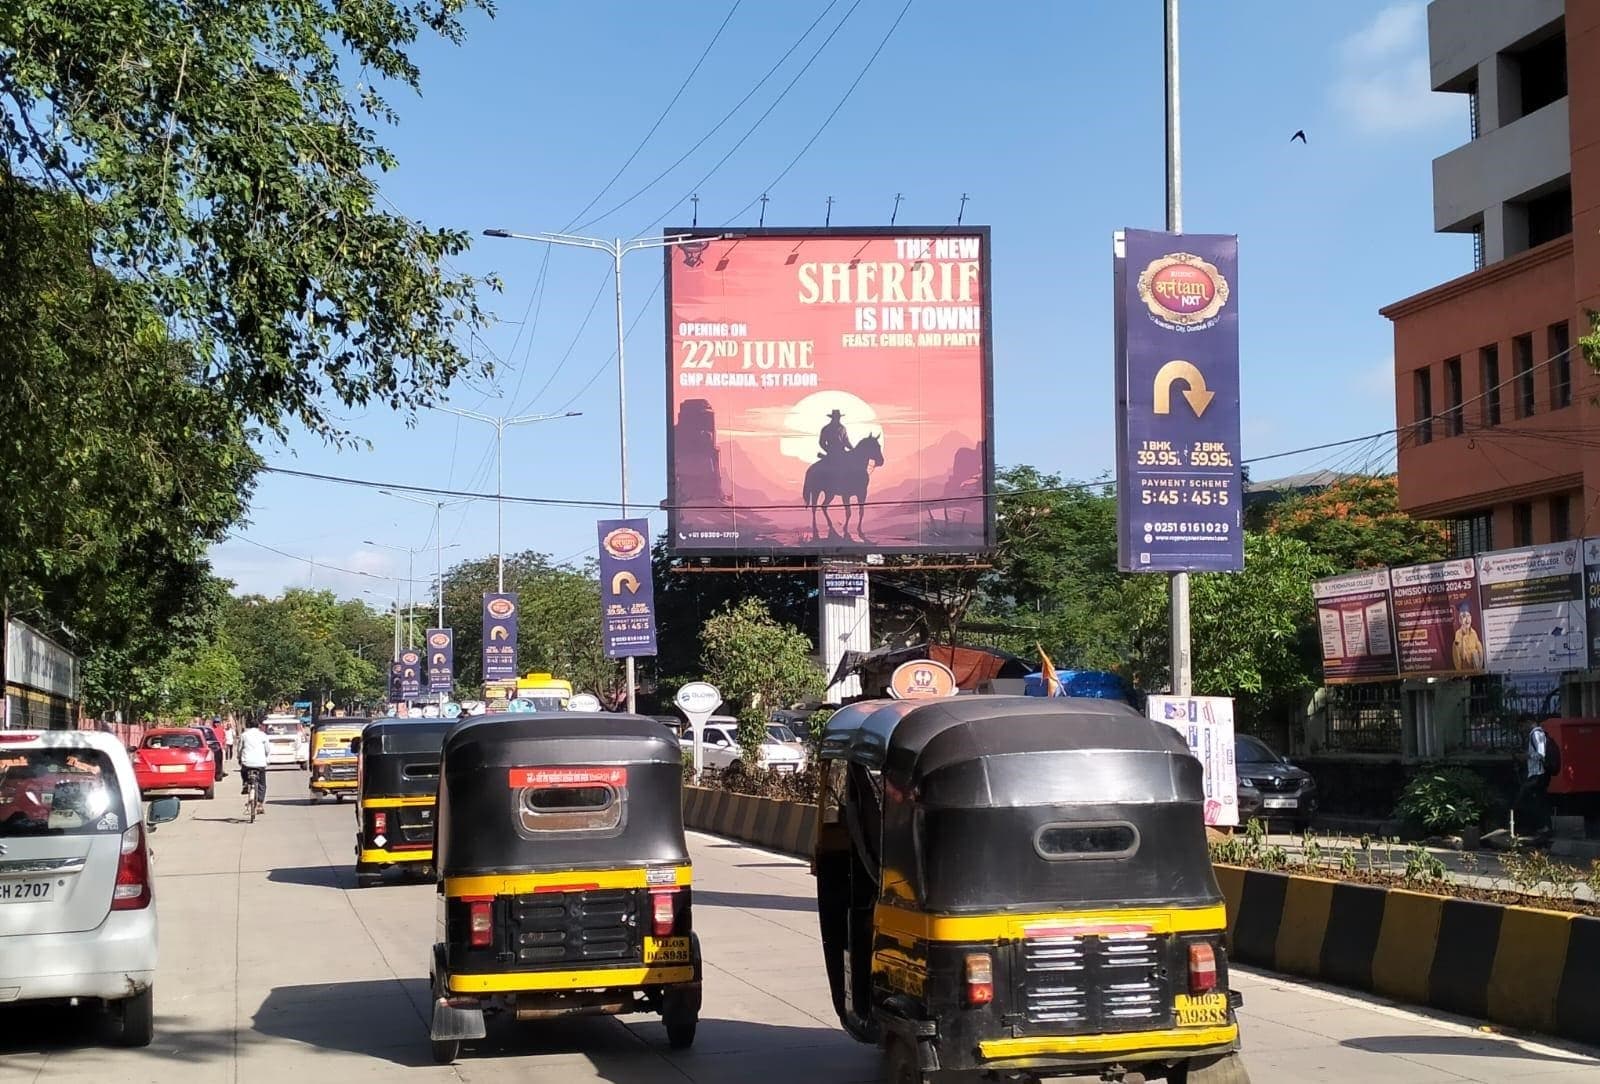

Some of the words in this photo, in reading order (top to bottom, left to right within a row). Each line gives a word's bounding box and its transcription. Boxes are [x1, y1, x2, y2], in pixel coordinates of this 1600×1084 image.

[894, 238, 932, 259] THE
[935, 238, 980, 259] NEW
[798, 261, 979, 304] SHERRIF
[1181, 295, 1202, 307] NXT
[855, 307, 877, 331] IS
[881, 306, 904, 331] IN
[908, 306, 980, 331] TOWN!
[678, 323, 729, 336] OPENING
[730, 323, 747, 336] ON
[879, 333, 915, 348] CHUG,
[917, 333, 942, 347] AND
[943, 332, 980, 347] PARTY
[681, 339, 738, 369] 22ND
[741, 340, 815, 370] JUNE
[761, 373, 781, 386] 1ST
[783, 373, 818, 387] FLOOR
[1149, 441, 1171, 450] BHK
[1202, 442, 1224, 452] BHK
[1141, 479, 1186, 487] PAYMENT
[1154, 522, 1178, 533] 0251
[1179, 522, 1229, 533] 6161029
[1394, 586, 1427, 598] ADMISSION
[1427, 583, 1445, 594] OPEN
[0, 884, 11, 899] H
[15, 883, 50, 898] 2707
